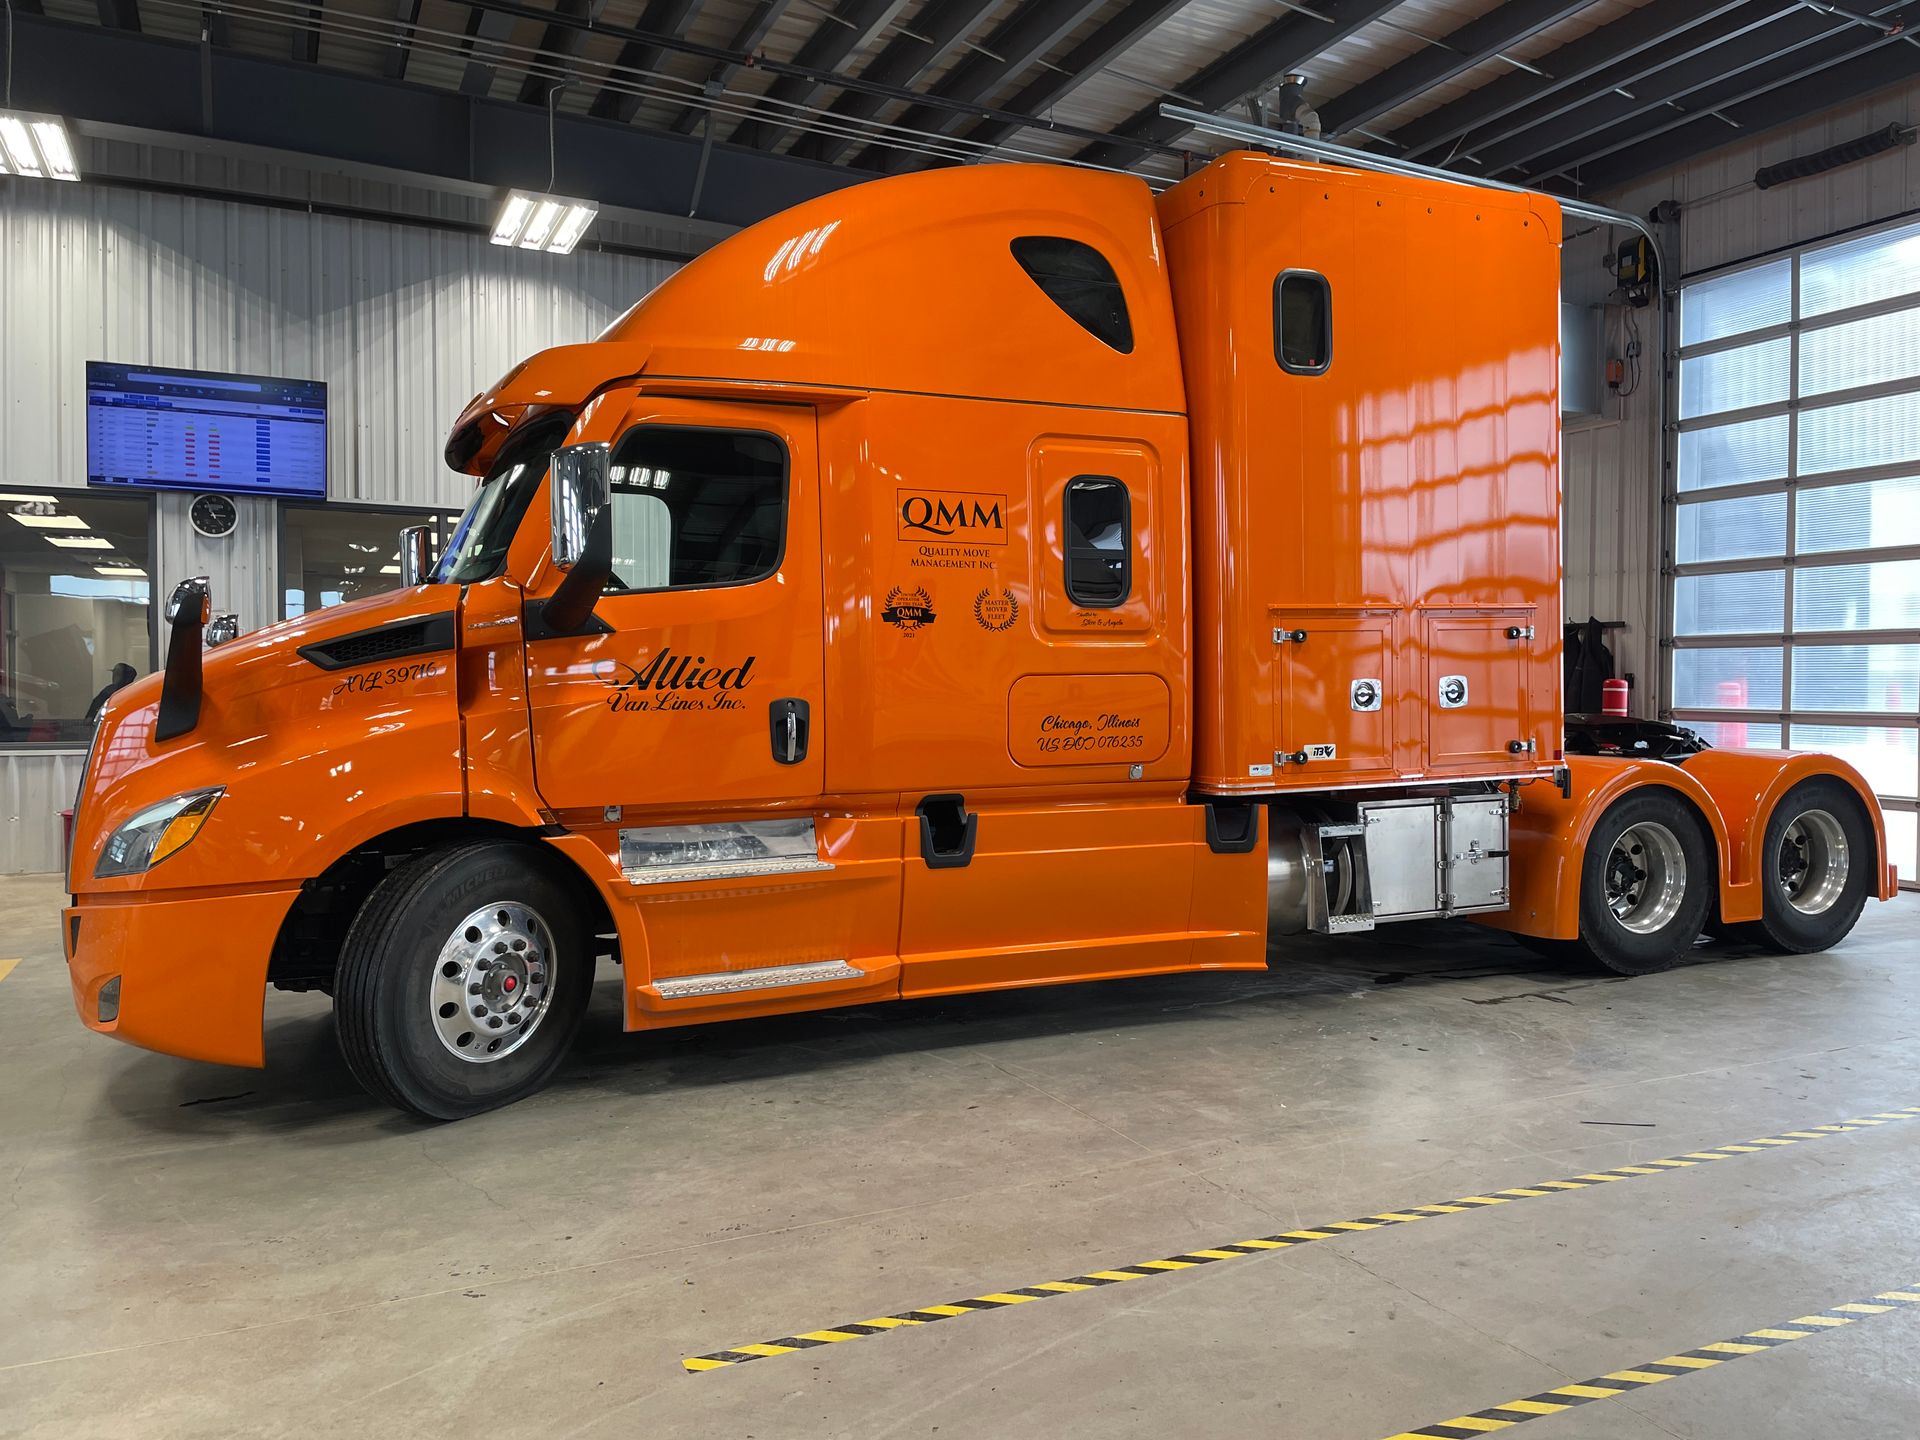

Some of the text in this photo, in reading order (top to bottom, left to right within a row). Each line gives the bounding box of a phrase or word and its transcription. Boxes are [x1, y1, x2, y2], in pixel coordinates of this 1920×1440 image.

[902, 497, 1004, 535] QMM
[919, 545, 990, 557] QUALITY MOVE
[910, 558, 976, 568] MANAGEMENT
[896, 607, 922, 619] QMM
[384, 661, 440, 685] 39716
[592, 647, 757, 691] Allied
[606, 691, 746, 713] Van Lines Inc.
[1041, 714, 1141, 736] Chicago, Illinois
[1037, 735, 1144, 753] US DOT 076235
